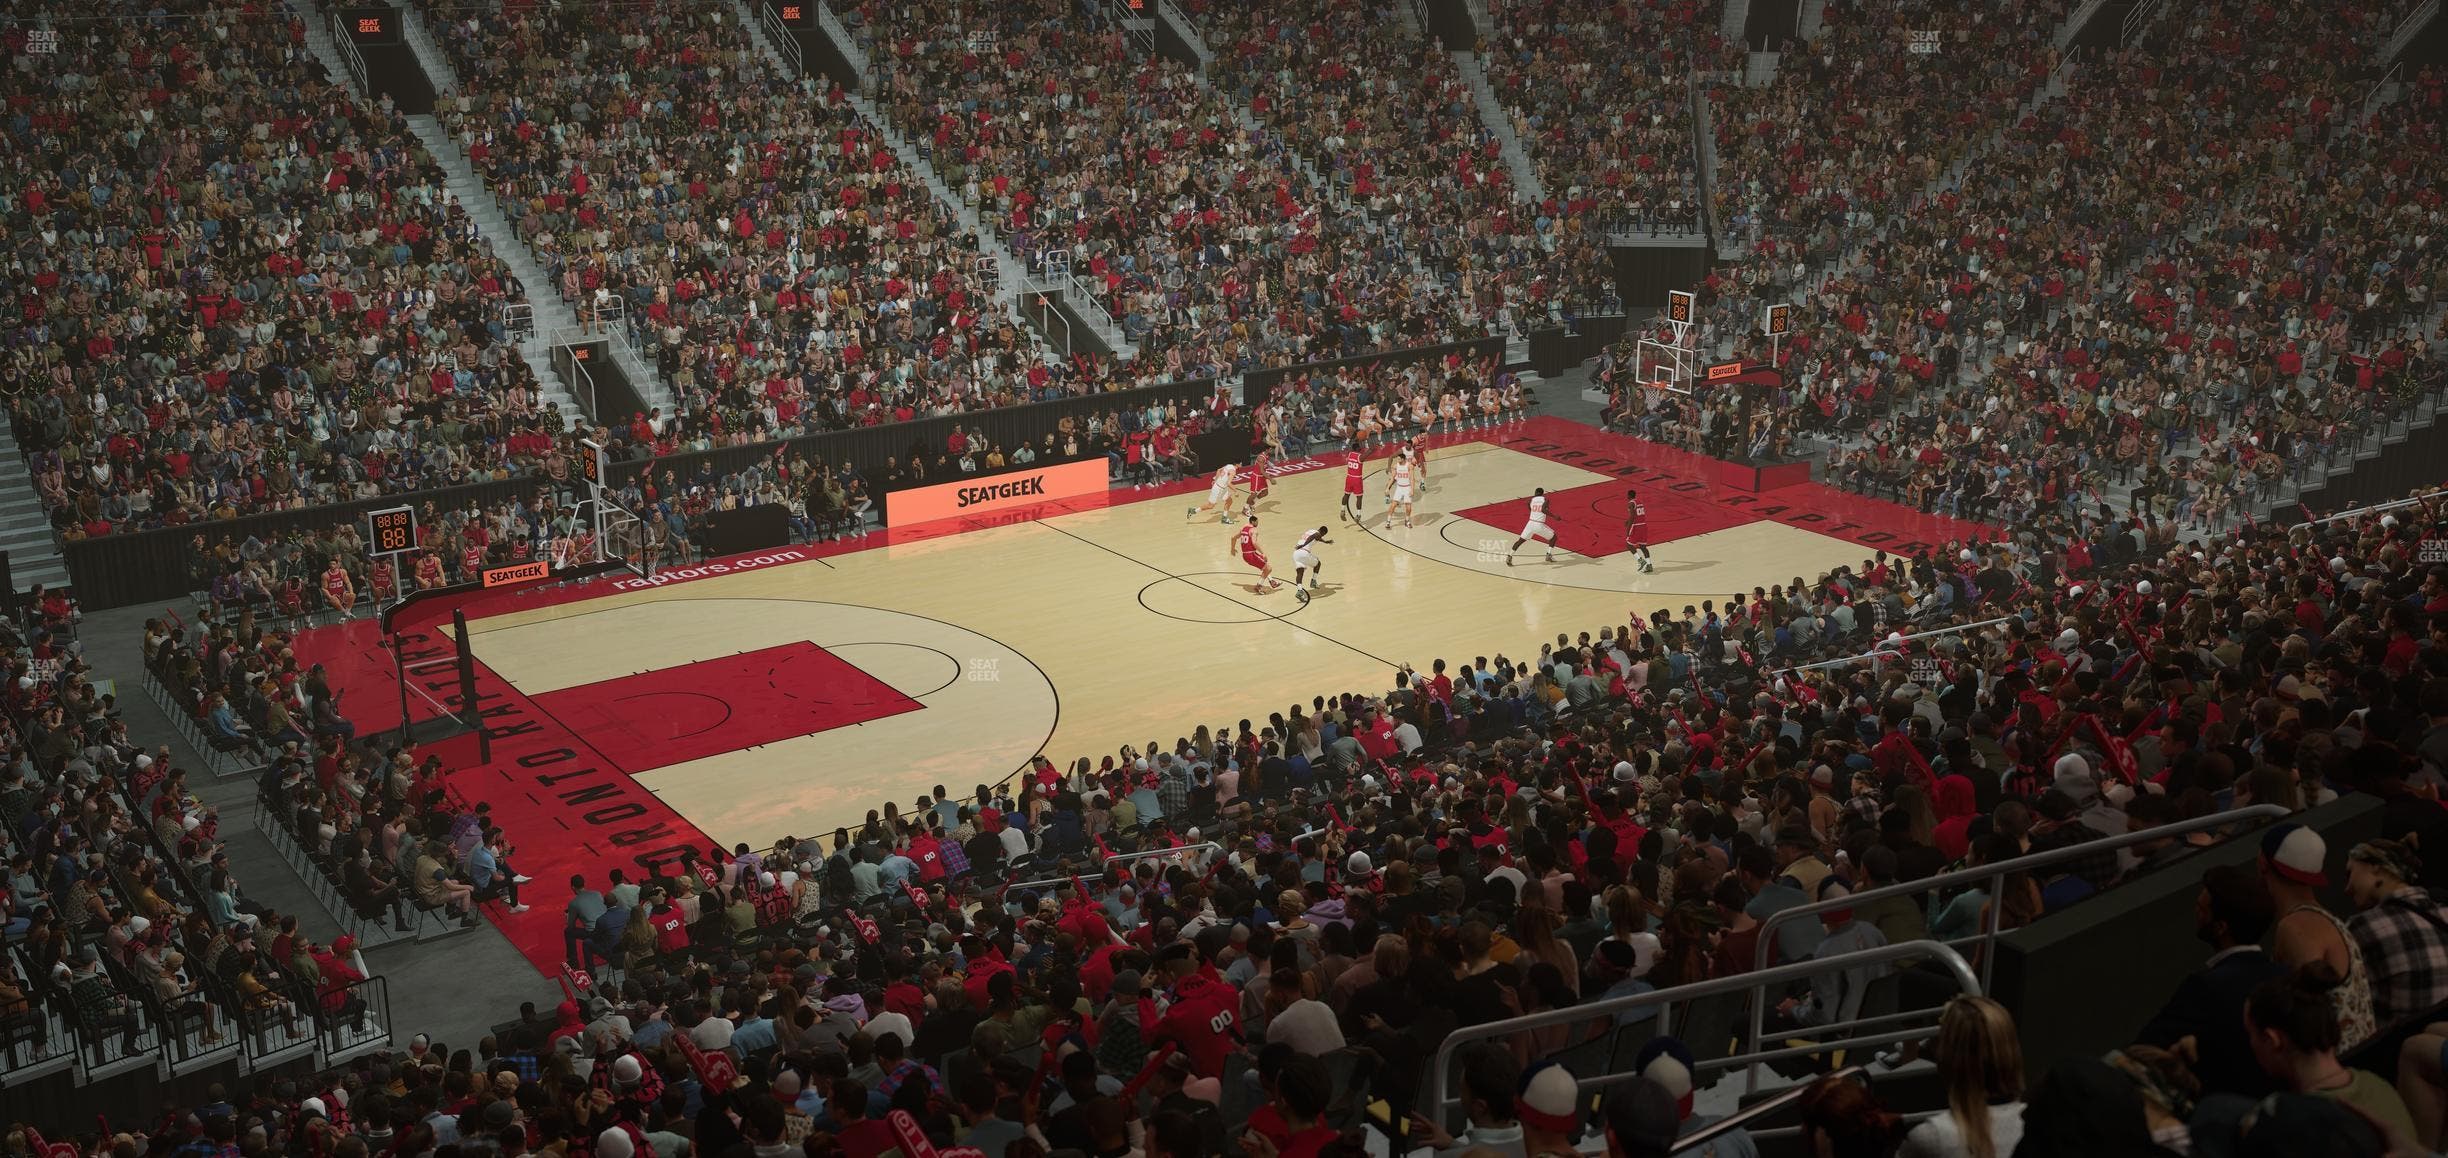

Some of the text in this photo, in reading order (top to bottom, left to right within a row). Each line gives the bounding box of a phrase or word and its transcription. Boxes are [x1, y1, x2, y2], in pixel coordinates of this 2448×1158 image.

[359, 25, 381, 33] GEEK
[360, 18, 379, 26] SEAT
[1712, 366, 1737, 376] SEATGEEK
[1503, 437, 1706, 491] TORONTO
[958, 475, 1044, 508] SEATGEEK
[377, 513, 407, 528] 88 88
[1718, 494, 1934, 553] RAPTOR
[382, 527, 406, 549] 88
[489, 563, 543, 584] SEATGEEK
[611, 550, 805, 589] raptors.com
[516, 747, 703, 870] ORONTO
[924, 852, 936, 862] 00
[666, 919, 679, 930] 00
[1211, 1009, 1233, 1033] 00
